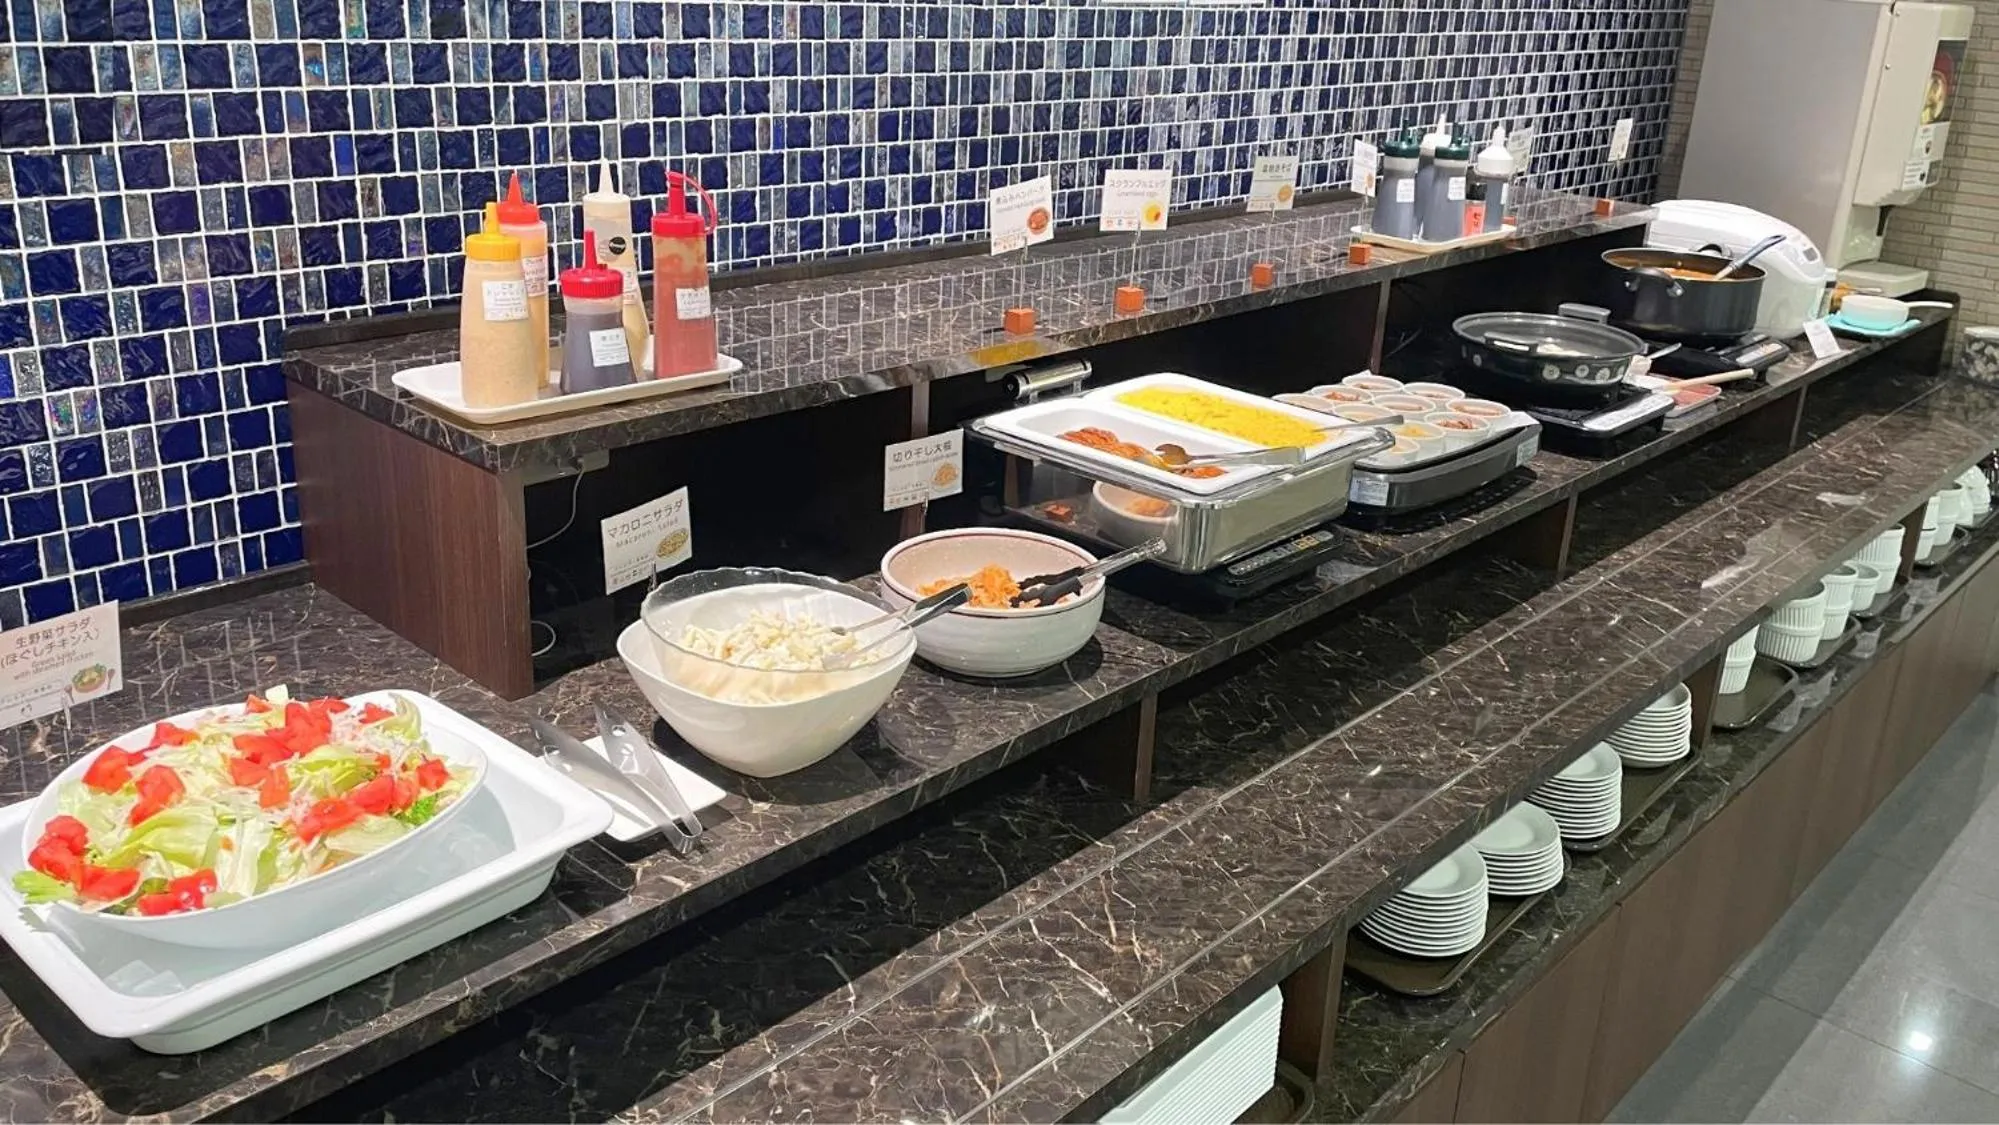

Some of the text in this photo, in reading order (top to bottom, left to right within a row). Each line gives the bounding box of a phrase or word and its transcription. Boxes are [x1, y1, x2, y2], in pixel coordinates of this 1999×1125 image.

[893, 440, 953, 462] 切り干し大根
[607, 499, 684, 538] マカロニサラダ
[16, 617, 91, 649] 生野菜サラダ
